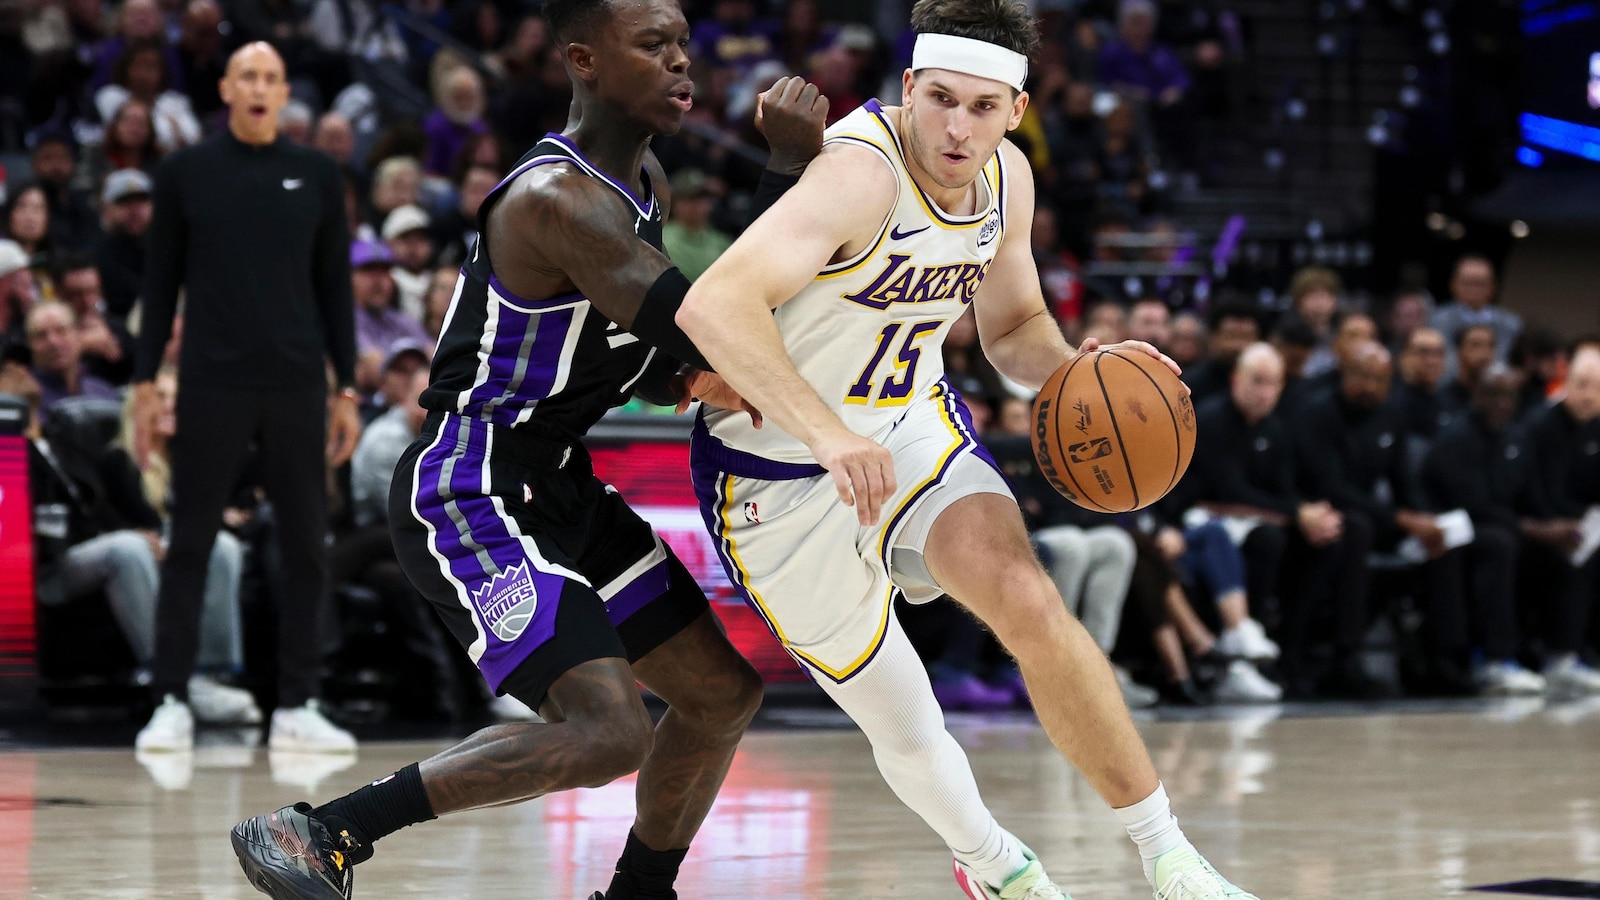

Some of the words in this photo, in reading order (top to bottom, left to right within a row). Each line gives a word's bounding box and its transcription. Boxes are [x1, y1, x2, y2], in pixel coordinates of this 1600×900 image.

[840, 252, 993, 312] LAKERS
[843, 319, 948, 408] 15
[481, 577, 528, 612] SACRAMENTO
[485, 585, 534, 627] KINGS
